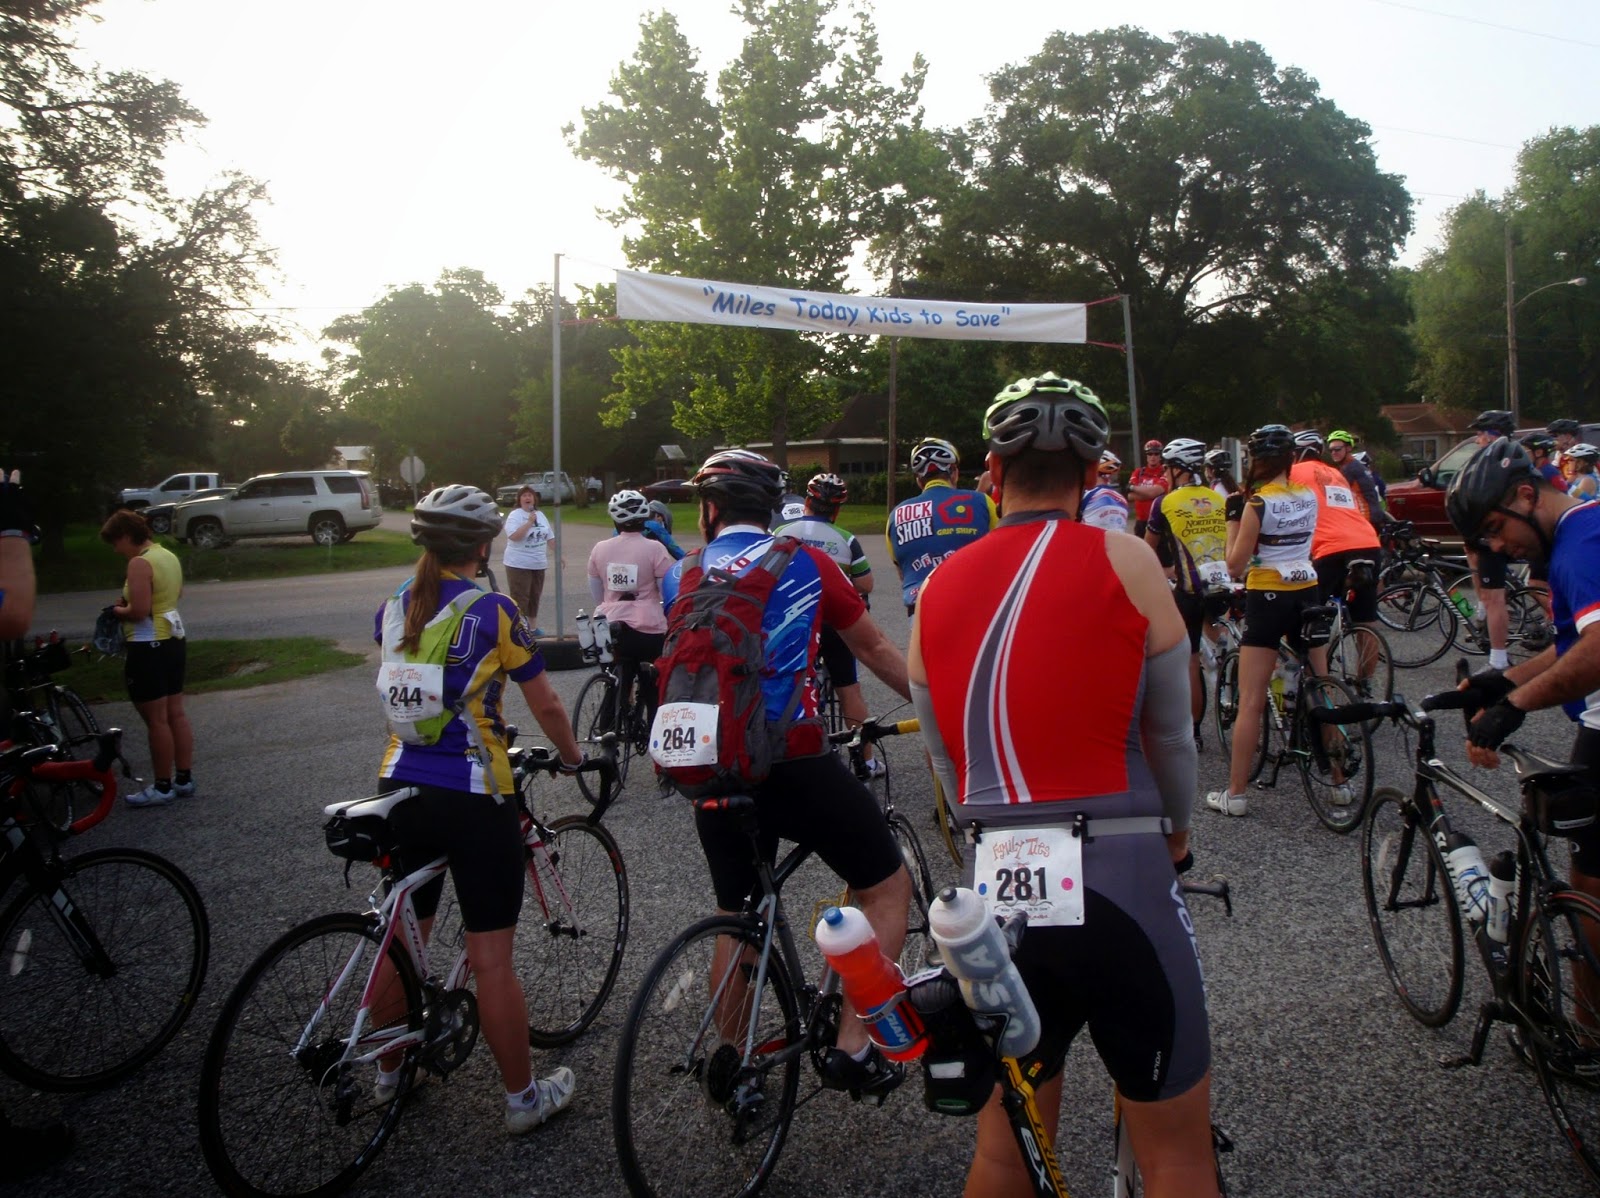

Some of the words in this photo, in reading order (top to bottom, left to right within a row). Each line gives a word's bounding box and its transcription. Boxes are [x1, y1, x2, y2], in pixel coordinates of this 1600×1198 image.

[703, 285, 776, 316] "Miles
[789, 296, 860, 327] Today
[866, 306, 912, 324] Kids
[919, 308, 943, 325] to
[956, 306, 1010, 327] Save"
[896, 502, 932, 524] ROCK
[1277, 515, 1310, 529] Energy
[897, 518, 933, 546] SHOX
[612, 574, 628, 584] 384
[389, 685, 422, 707] 244
[662, 726, 697, 751] 264
[993, 836, 1025, 861] Family
[1025, 837, 1050, 858] Ties
[995, 866, 1048, 901] 281
[886, 1011, 910, 1043] GIAN
